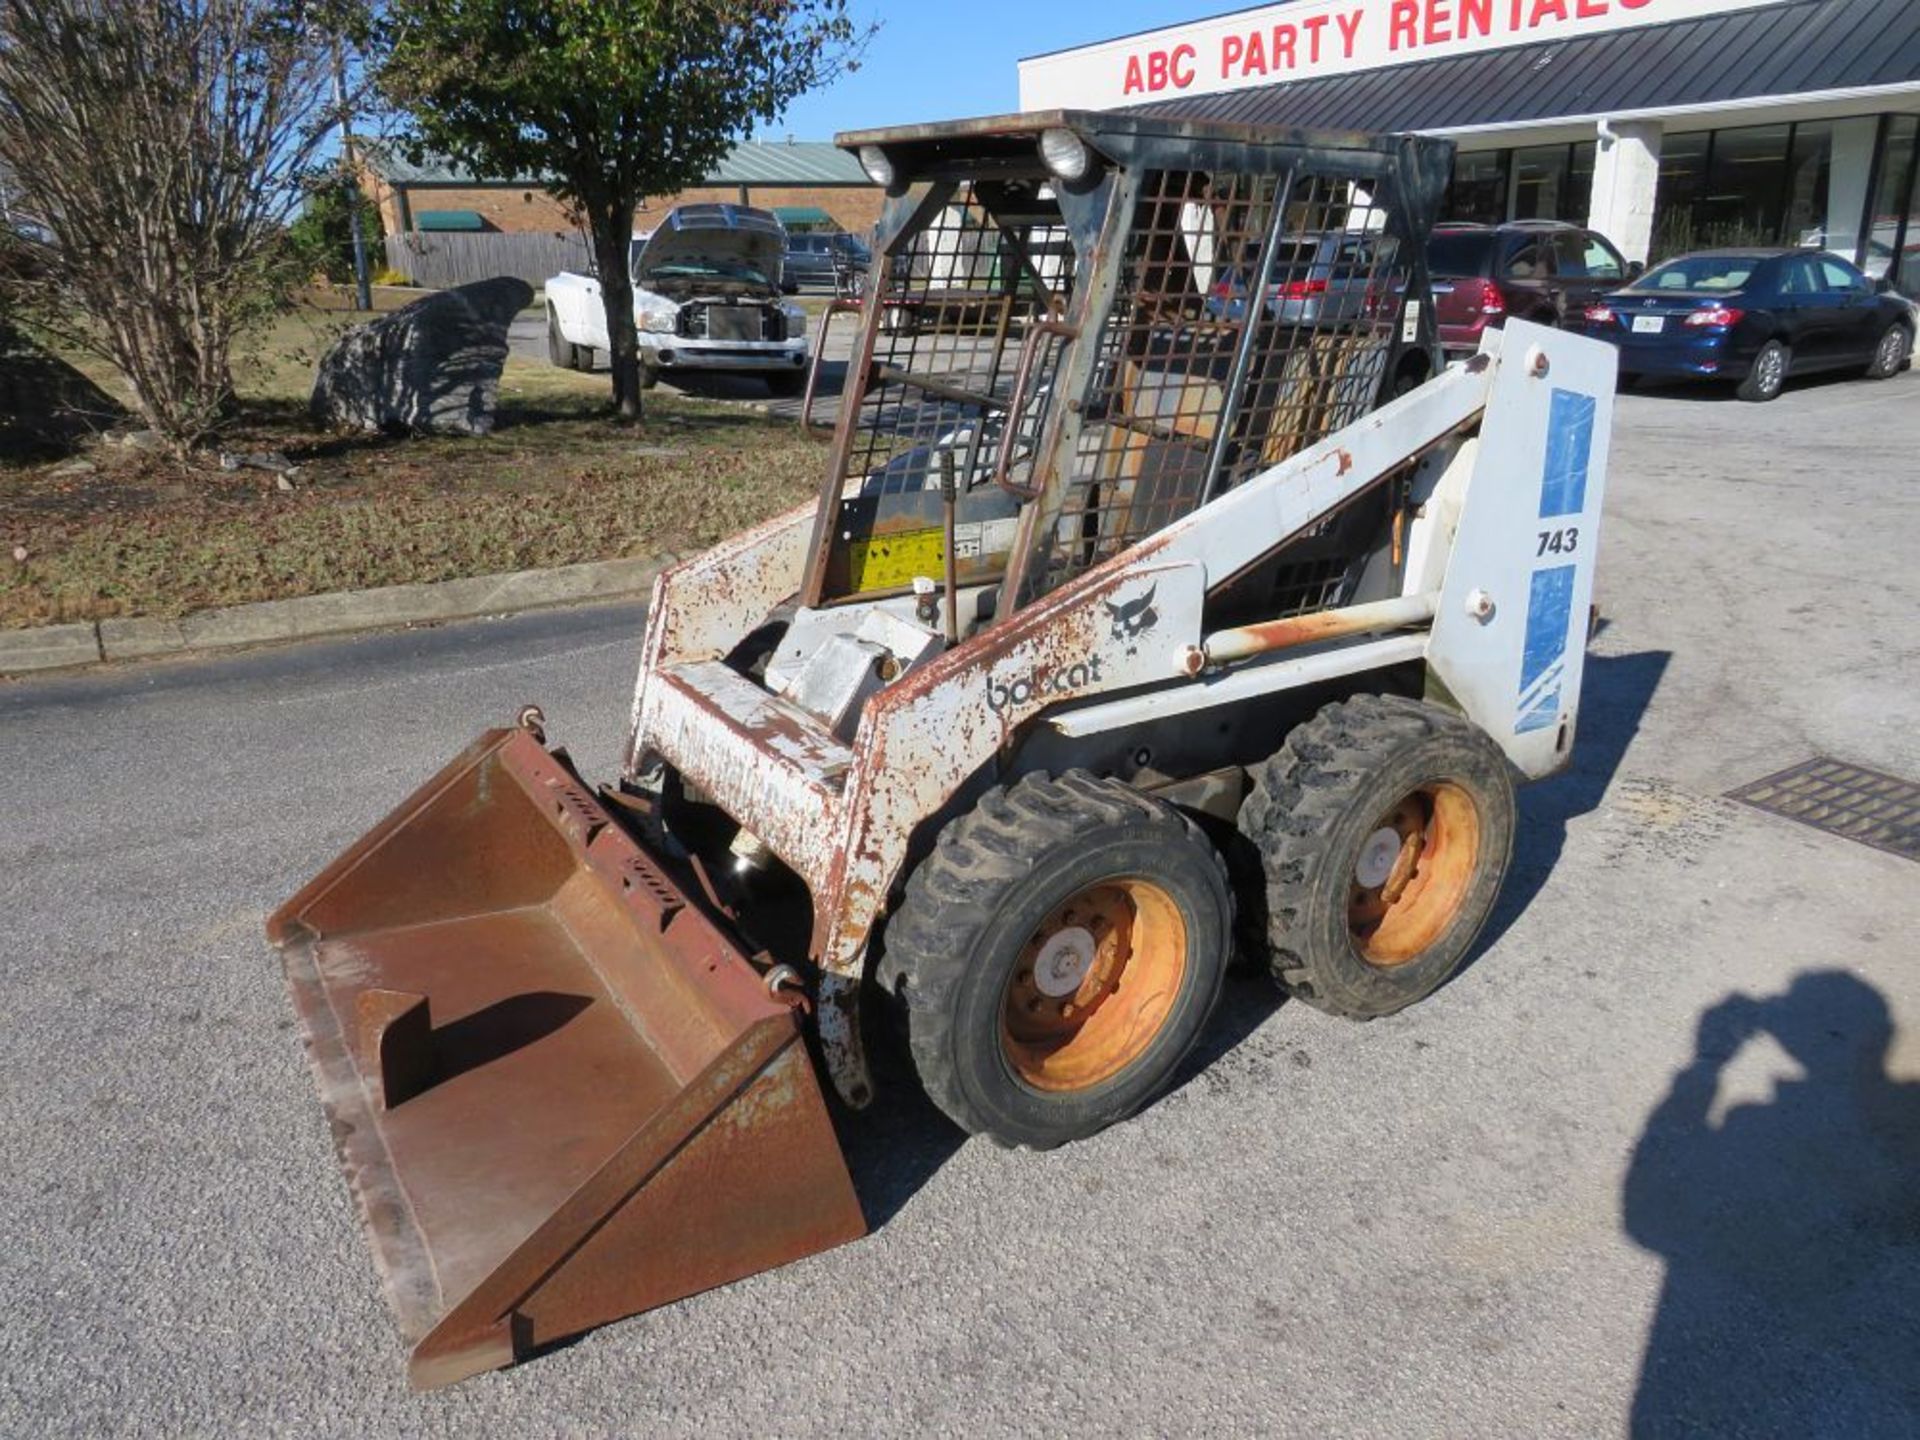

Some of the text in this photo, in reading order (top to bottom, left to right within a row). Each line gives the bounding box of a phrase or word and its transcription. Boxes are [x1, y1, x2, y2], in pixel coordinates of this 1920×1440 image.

[1123, 0, 1651, 95] ABC PARTY RENTA
[1536, 527, 1579, 557] 743
